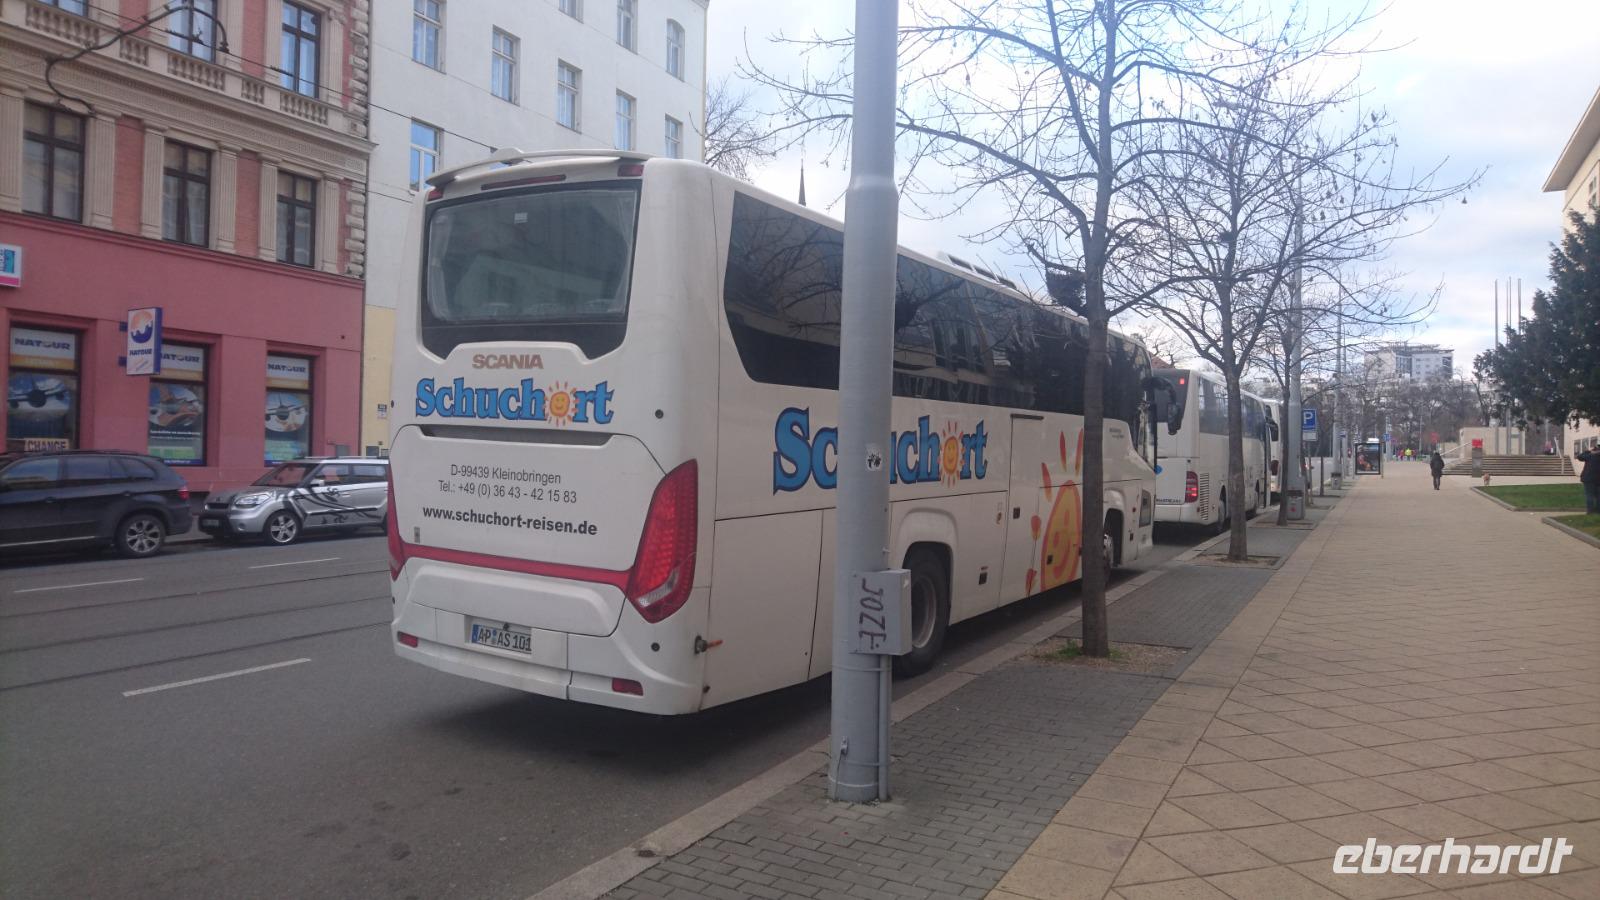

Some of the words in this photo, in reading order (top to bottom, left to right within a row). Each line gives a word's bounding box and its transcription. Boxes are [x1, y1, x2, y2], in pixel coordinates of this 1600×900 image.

[14, 338, 71, 350] NATOUR
[129, 348, 153, 356] NATOUR
[267, 363, 306, 373] NATOUR
[472, 354, 544, 370] SCANIA
[415, 376, 614, 425] Schuchort
[1303, 411, 1314, 425] P
[451, 464, 489, 478] D-99439
[492, 467, 561, 486] Kleinobringen
[438, 479, 456, 493] Tel.:
[458, 482, 475, 494] +49
[478, 482, 491, 498] (0)
[493, 484, 506, 497] 36
[508, 486, 521, 499] 43
[530, 487, 543, 501] 42
[547, 489, 560, 502] 15
[563, 490, 577, 503] 83
[422, 506, 598, 535] www.schuchort-reisen.de
[478, 628, 492, 644] AP
[497, 631, 511, 648] AS
[512, 634, 532, 651] 101
